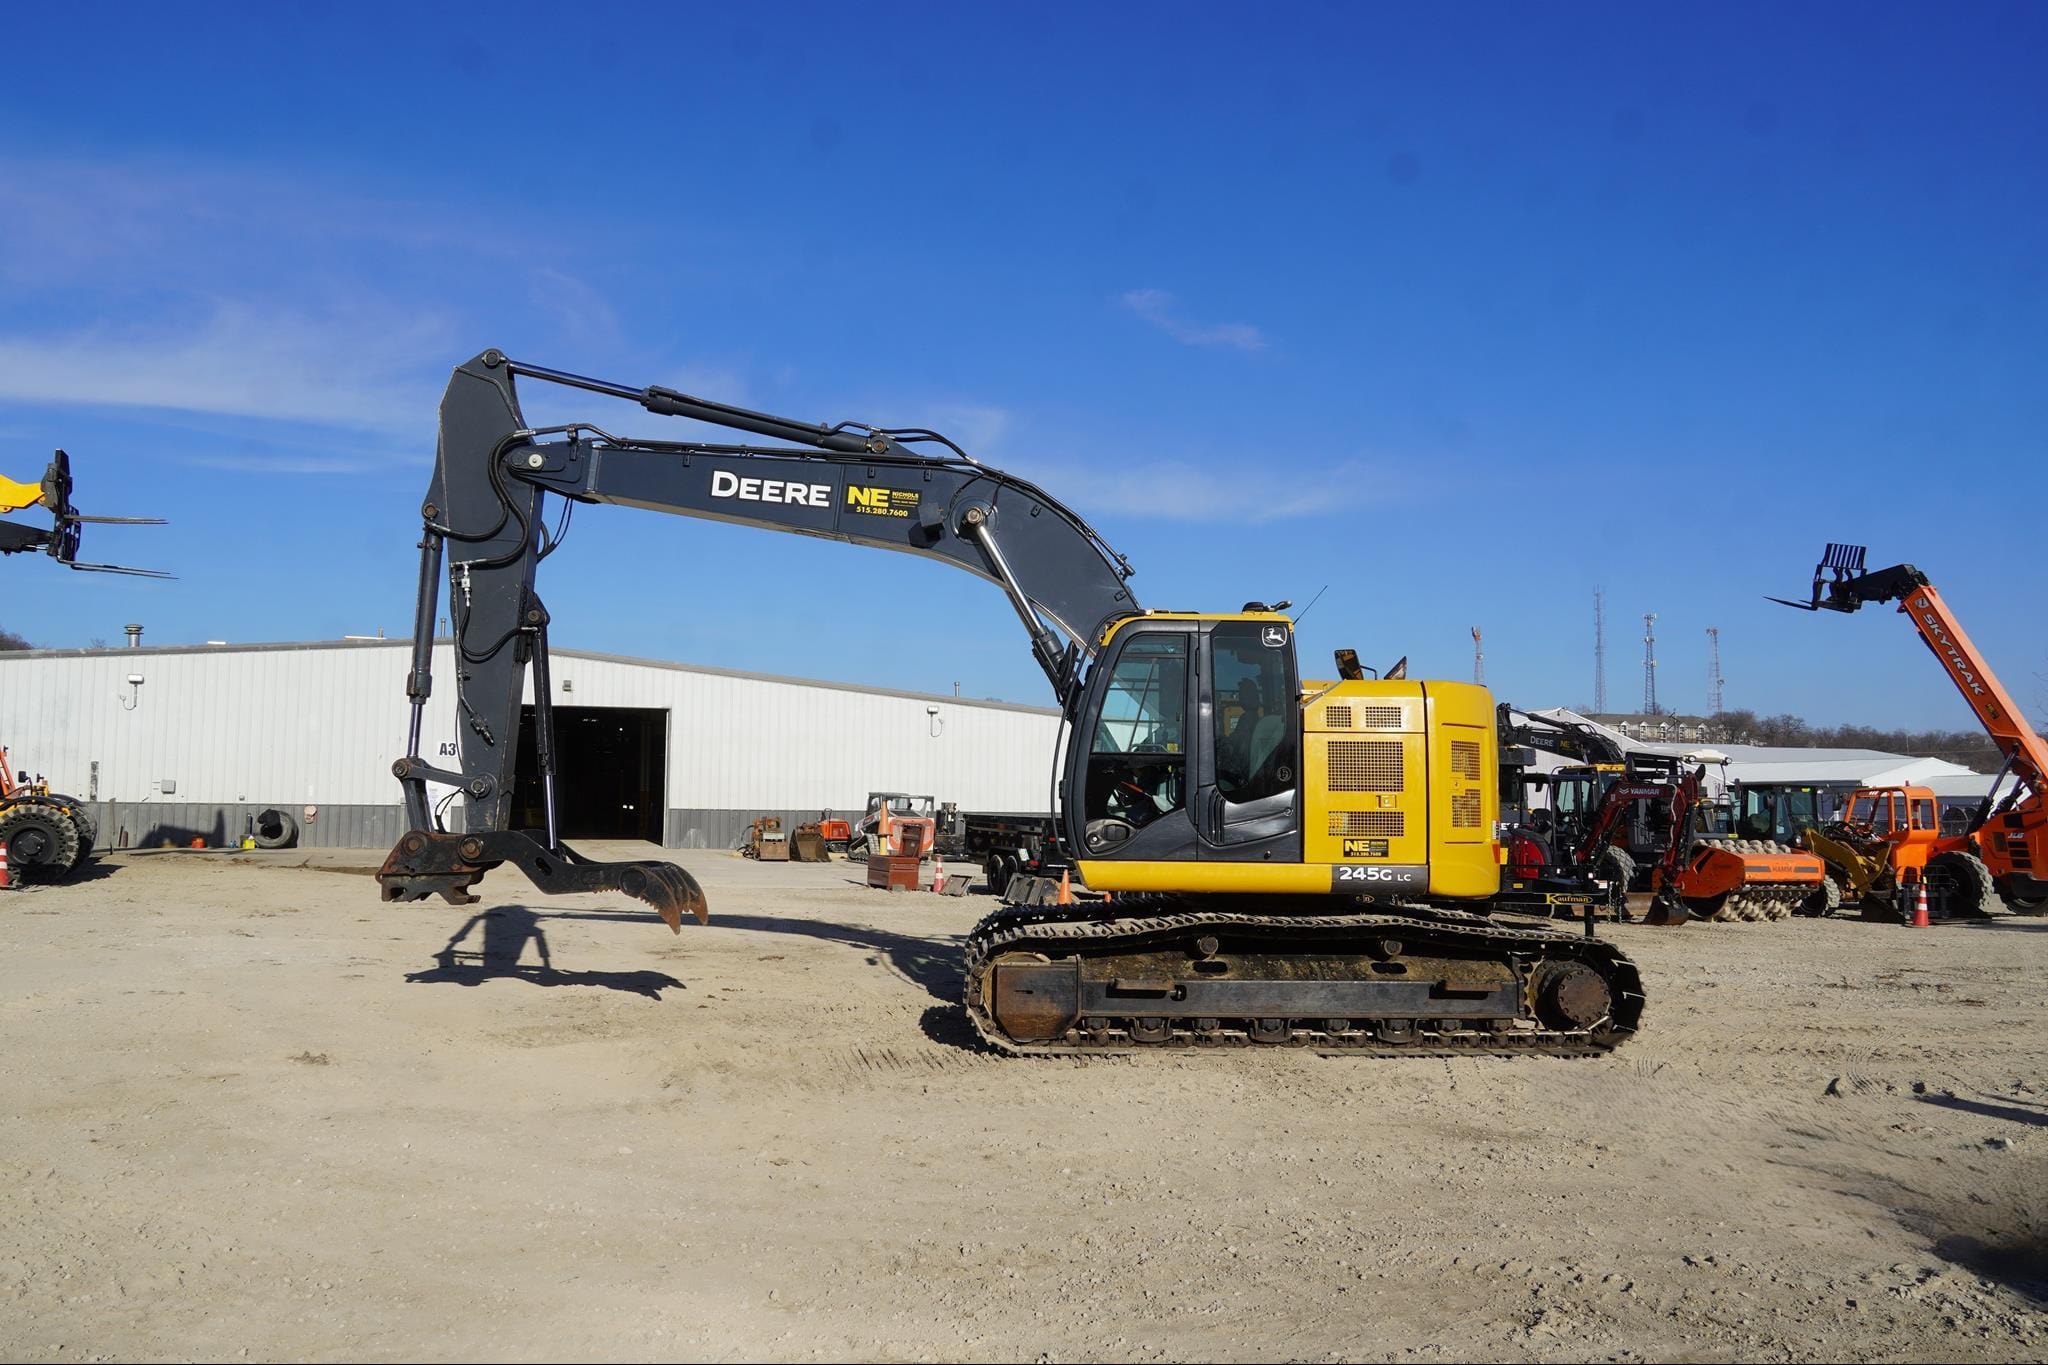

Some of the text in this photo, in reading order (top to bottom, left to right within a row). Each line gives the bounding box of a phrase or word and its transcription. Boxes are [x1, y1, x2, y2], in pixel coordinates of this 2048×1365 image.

[711, 470, 831, 508] DEERE
[847, 486, 890, 507] NE
[856, 506, 908, 517] 515.280.7600
[1923, 613, 1985, 696] SKYTRAK
[1530, 736, 1554, 747] DEERE
[440, 743, 457, 756] A3
[1345, 840, 1369, 851] NE
[1339, 866, 1411, 882] 245G LC
[1546, 893, 1588, 904] Kaufman
